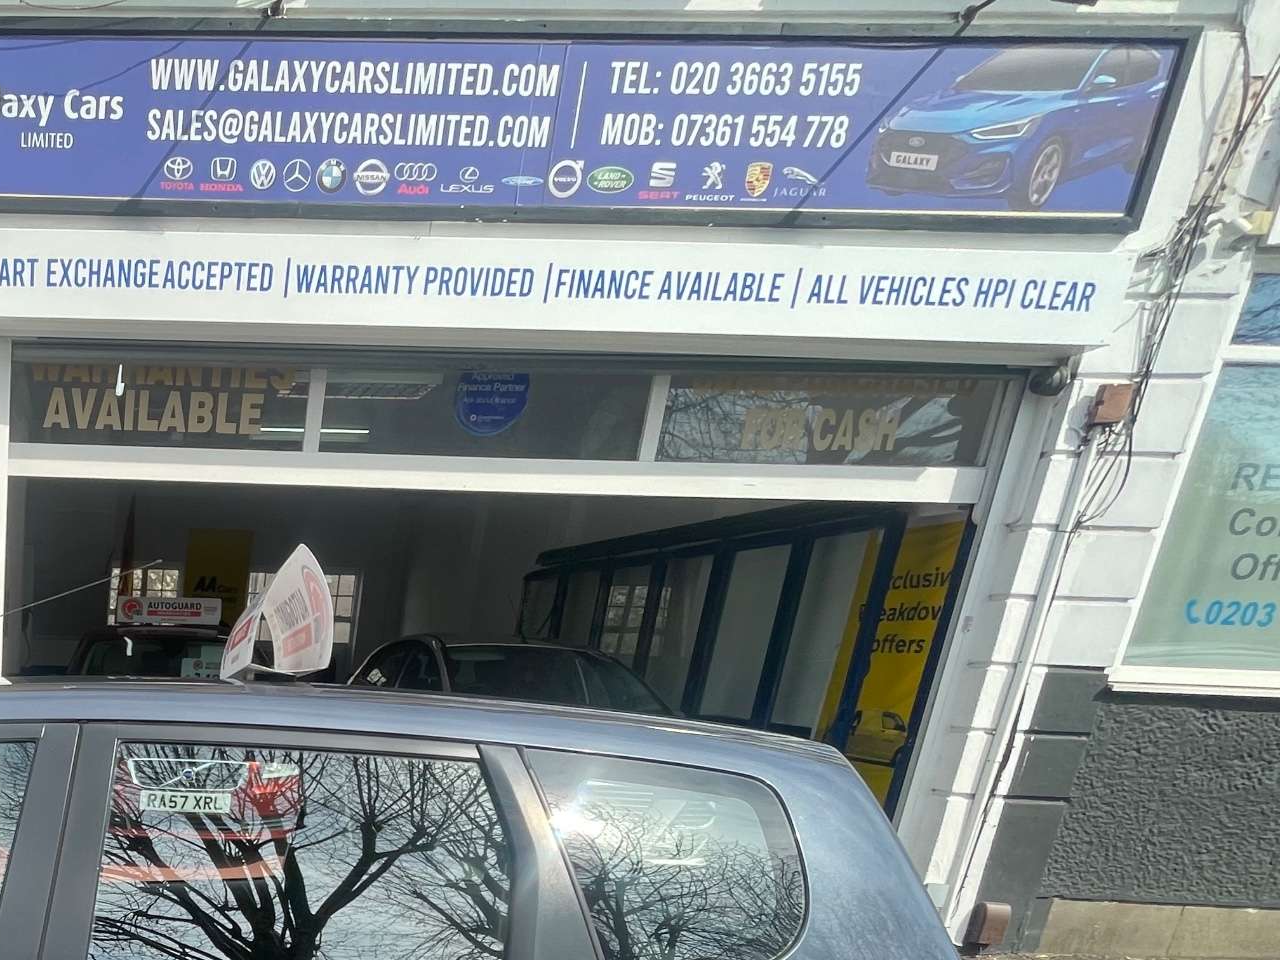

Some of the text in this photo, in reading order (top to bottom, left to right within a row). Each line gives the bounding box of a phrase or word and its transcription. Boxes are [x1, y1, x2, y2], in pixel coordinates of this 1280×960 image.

[149, 58, 561, 98] WWW.GALAXYCARSLIMITED.COM
[609, 61, 863, 98] TEL: 020 3663 5155
[63, 89, 124, 122] Cars
[147, 108, 551, 149] SALES@GALAXYCARSLIMITED.COM
[600, 114, 849, 150] MOB: 07361 554 778
[20, 131, 74, 150] LIMITED
[894, 153, 932, 168] GALAXY
[355, 174, 387, 183] NISSAN
[597, 172, 621, 181] LAND
[597, 180, 627, 189] ROVER
[160, 181, 195, 191] TOYOTA
[200, 183, 244, 193] HONDA
[397, 182, 430, 195] Audi
[440, 184, 495, 194] LEXUS
[637, 190, 681, 200] SEAT
[773, 186, 827, 198] JAGUAR
[685, 193, 736, 202] PEUGEOT
[45, 258, 160, 289] EXCHANGE
[162, 259, 274, 292] ACCEPTED
[295, 263, 422, 295] WARRANTY
[423, 266, 535, 298] PROVIDED
[555, 268, 655, 300] FINANCE
[657, 270, 786, 303] AVAILABLE
[806, 273, 848, 305] ALL
[858, 274, 966, 308] VEHICLES
[972, 276, 1017, 309] HPI
[1020, 279, 1097, 312] CLEAR
[42, 386, 265, 435] AVAILABLE
[740, 407, 903, 451] FOR CASH
[1228, 507, 1280, 537] Co
[889, 566, 952, 590] clusiv
[147, 601, 202, 611] AUTOGUARD
[1205, 599, 1277, 627] 0203
[146, 793, 223, 811] RA57 XRL
